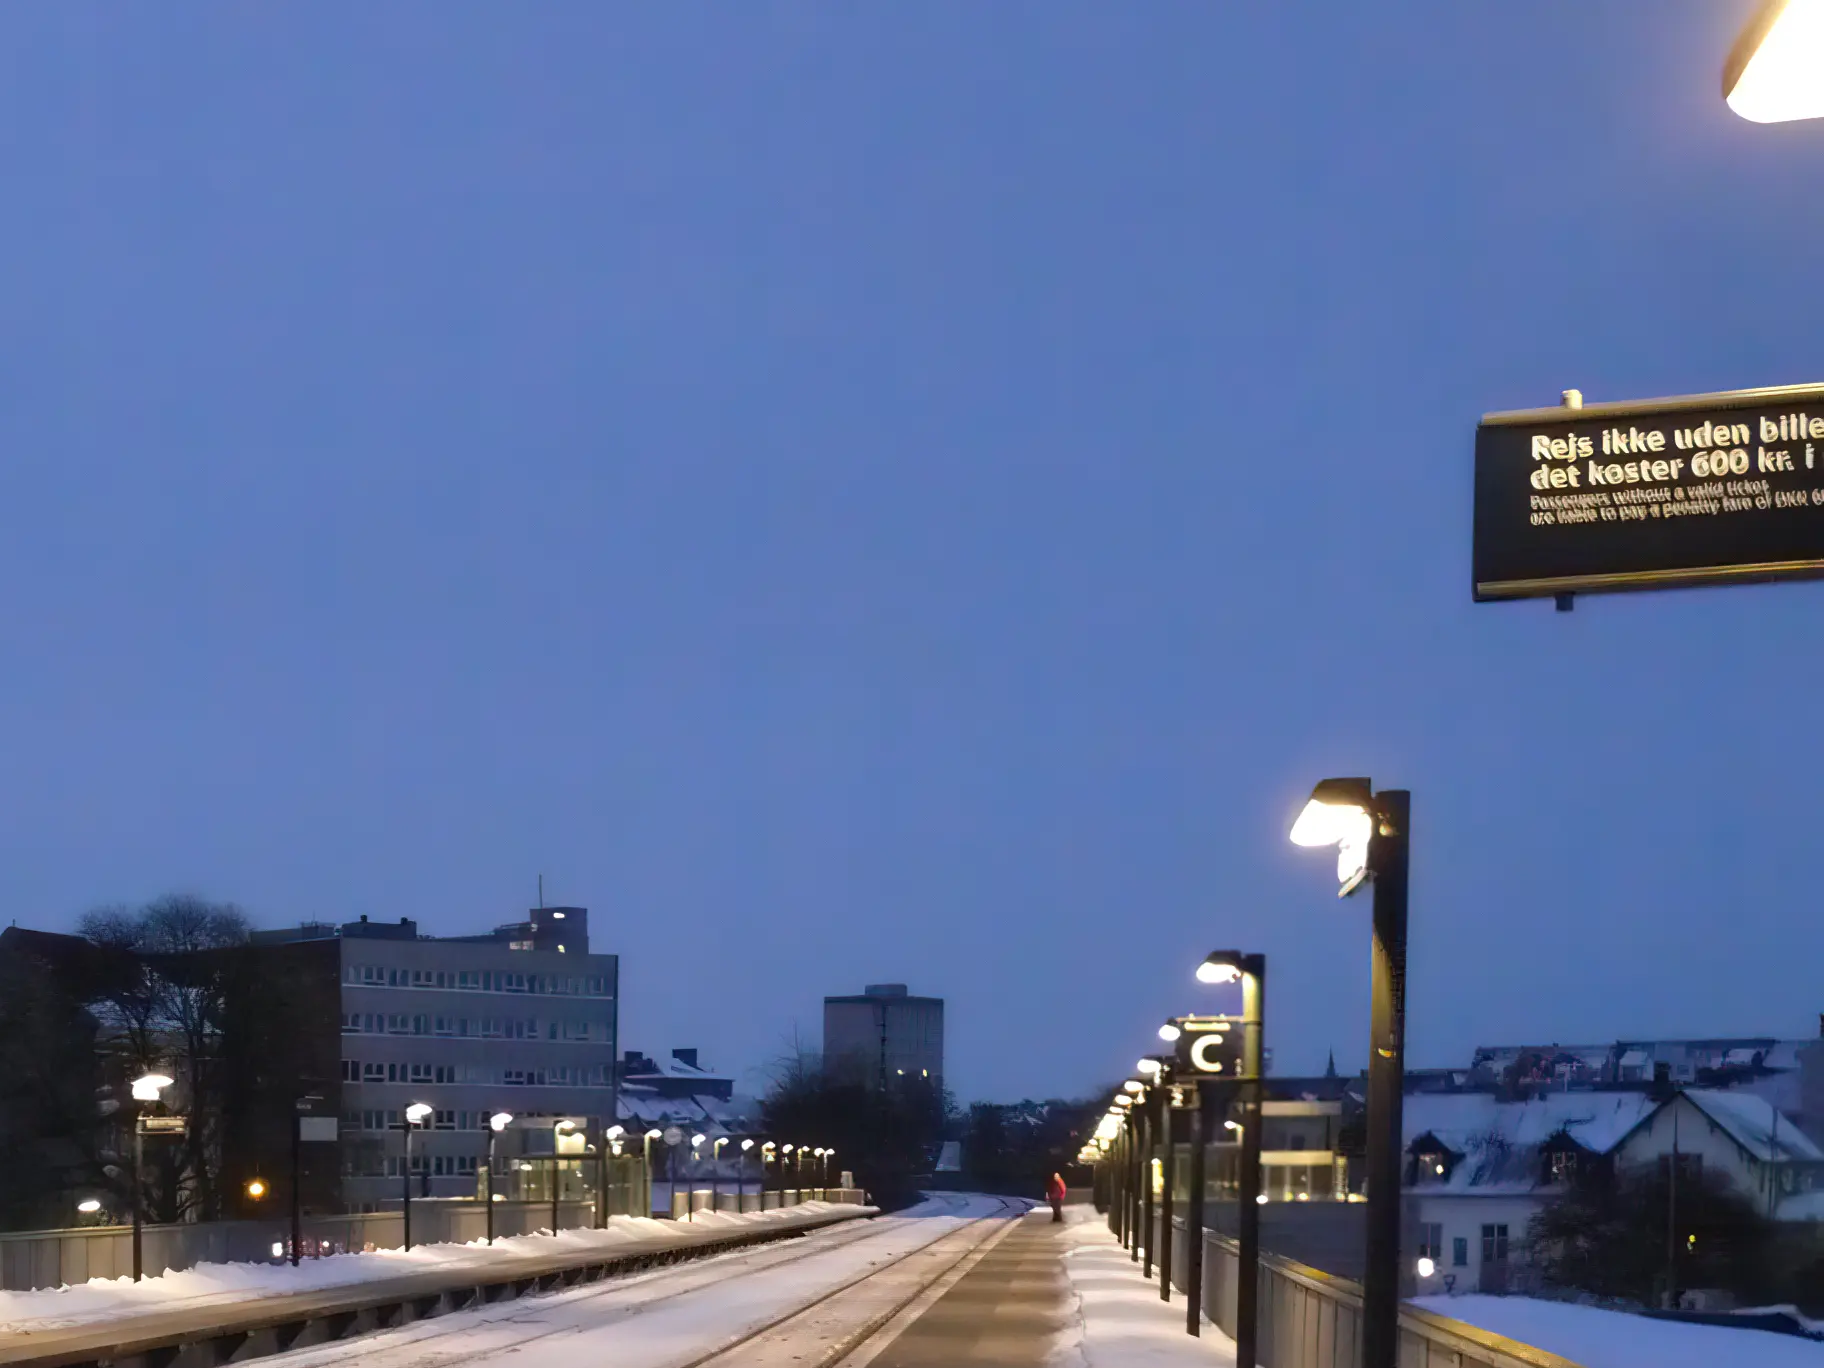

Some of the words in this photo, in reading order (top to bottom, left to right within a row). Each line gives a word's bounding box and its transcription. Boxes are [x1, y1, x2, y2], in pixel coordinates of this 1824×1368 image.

[1531, 432, 1594, 463] Rejs
[1602, 426, 1666, 456] ikke
[1674, 420, 1751, 450] uden
[1530, 463, 1581, 490] det
[1588, 456, 1685, 486] koster
[1691, 448, 1750, 478] 600
[1191, 1034, 1224, 1072] C
